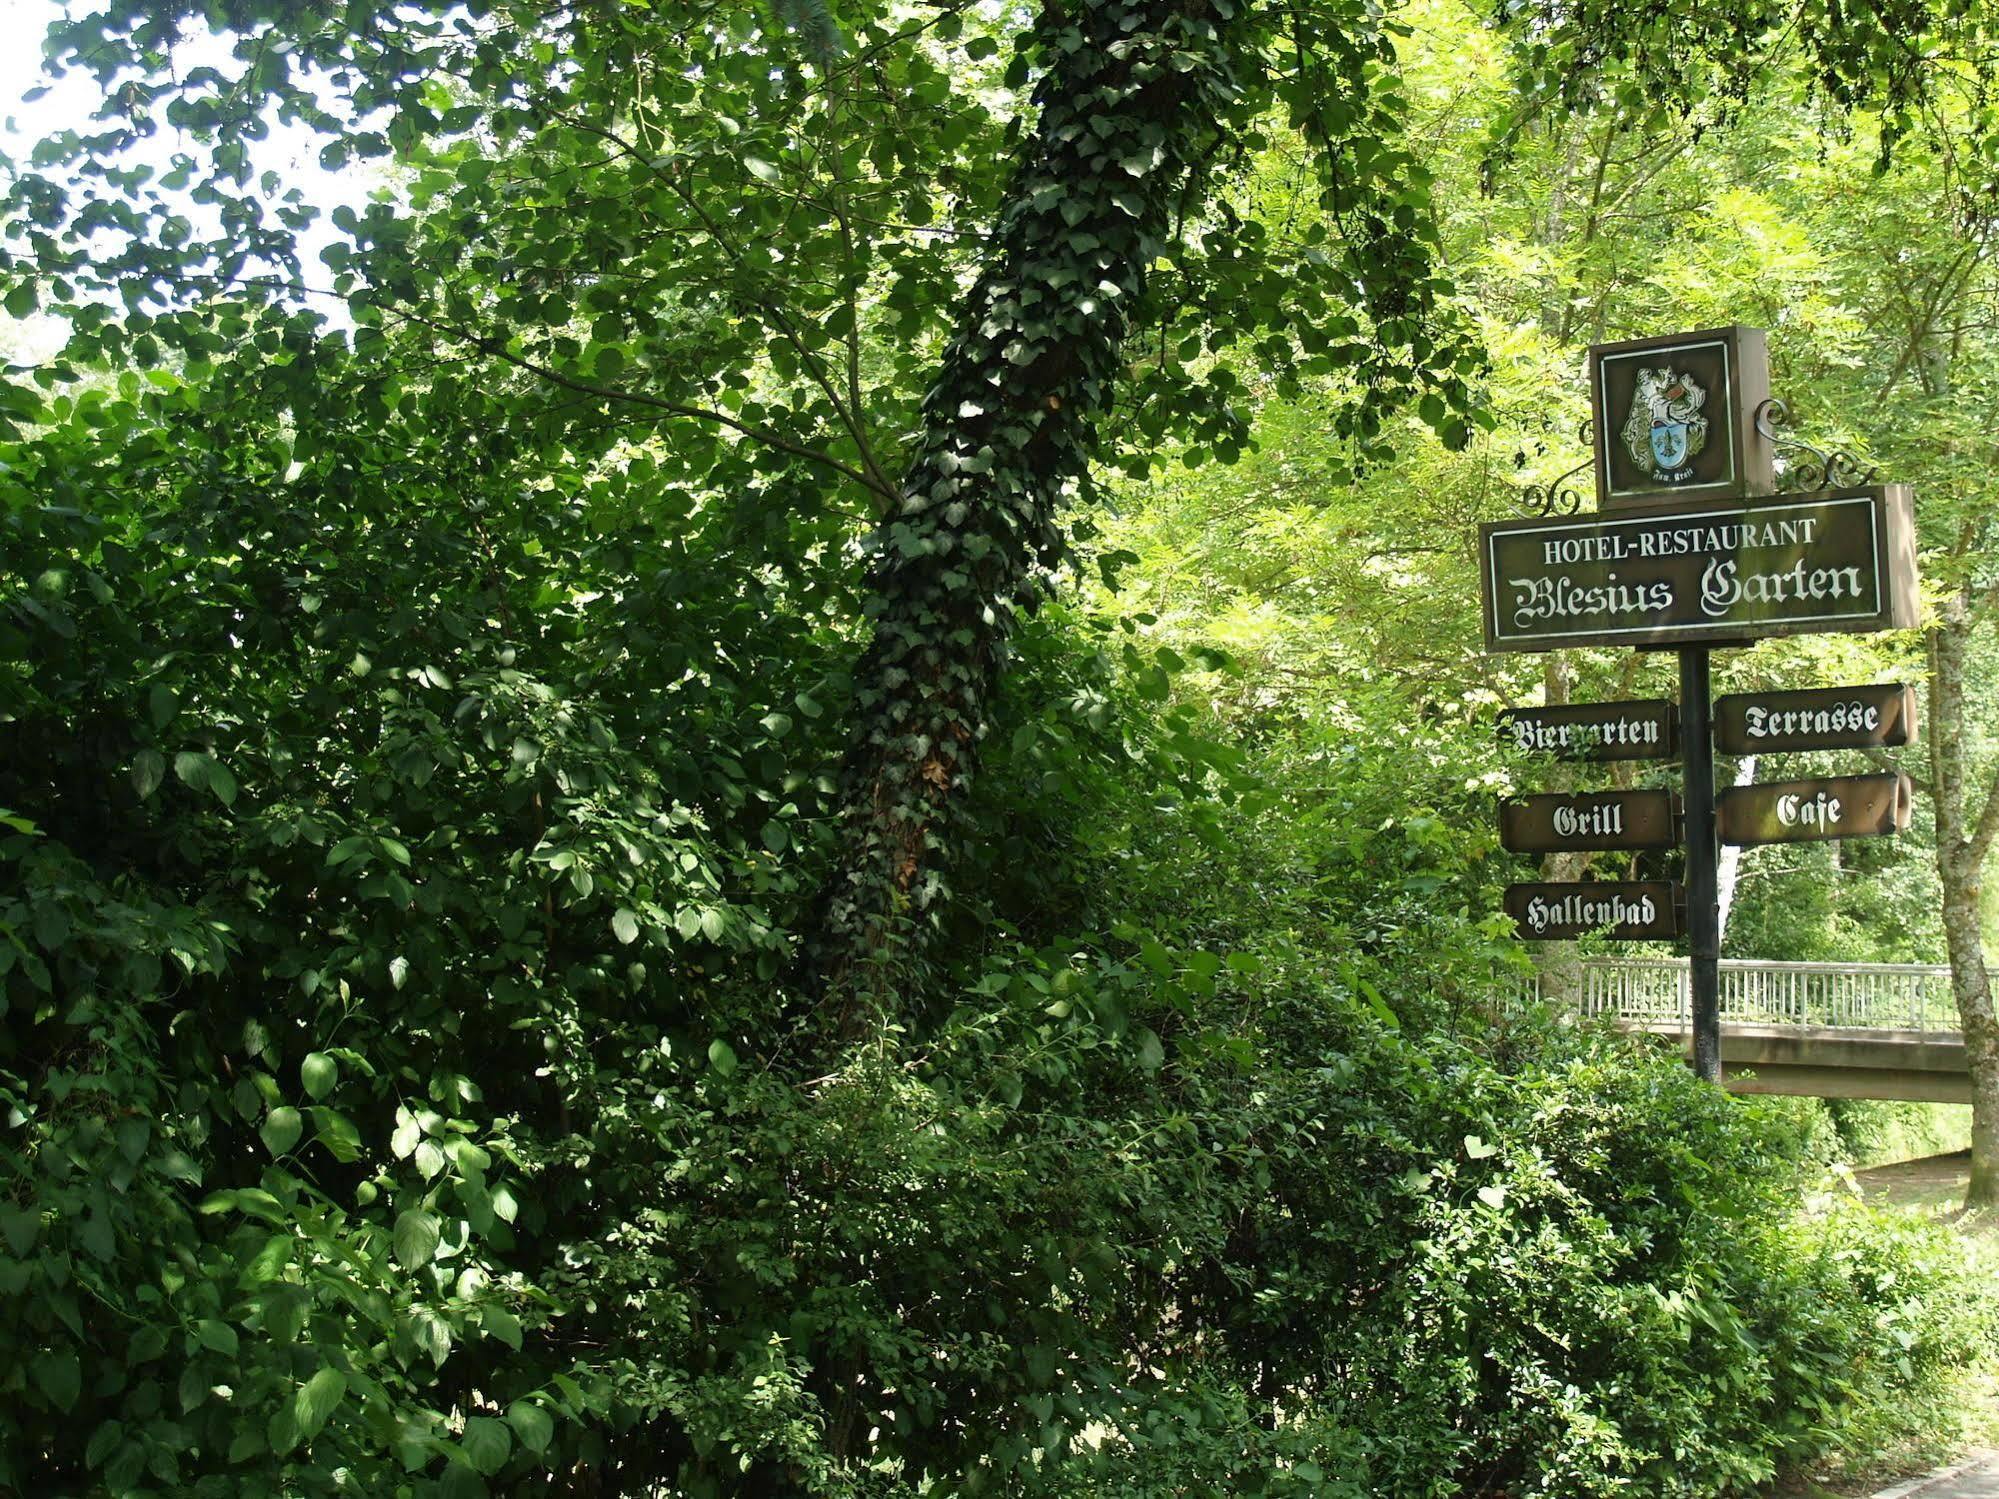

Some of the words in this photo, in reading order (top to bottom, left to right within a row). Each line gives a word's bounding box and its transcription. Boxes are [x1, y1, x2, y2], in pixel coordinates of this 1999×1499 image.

[1543, 517, 1817, 565] HOTEL-RESTAURANT
[1508, 573, 1674, 628] Blesius
[1700, 556, 1863, 617] Garten
[1745, 700, 1879, 738] Terrasse
[1553, 804, 1623, 837] Grill
[1527, 894, 1656, 934] Hallenbad
